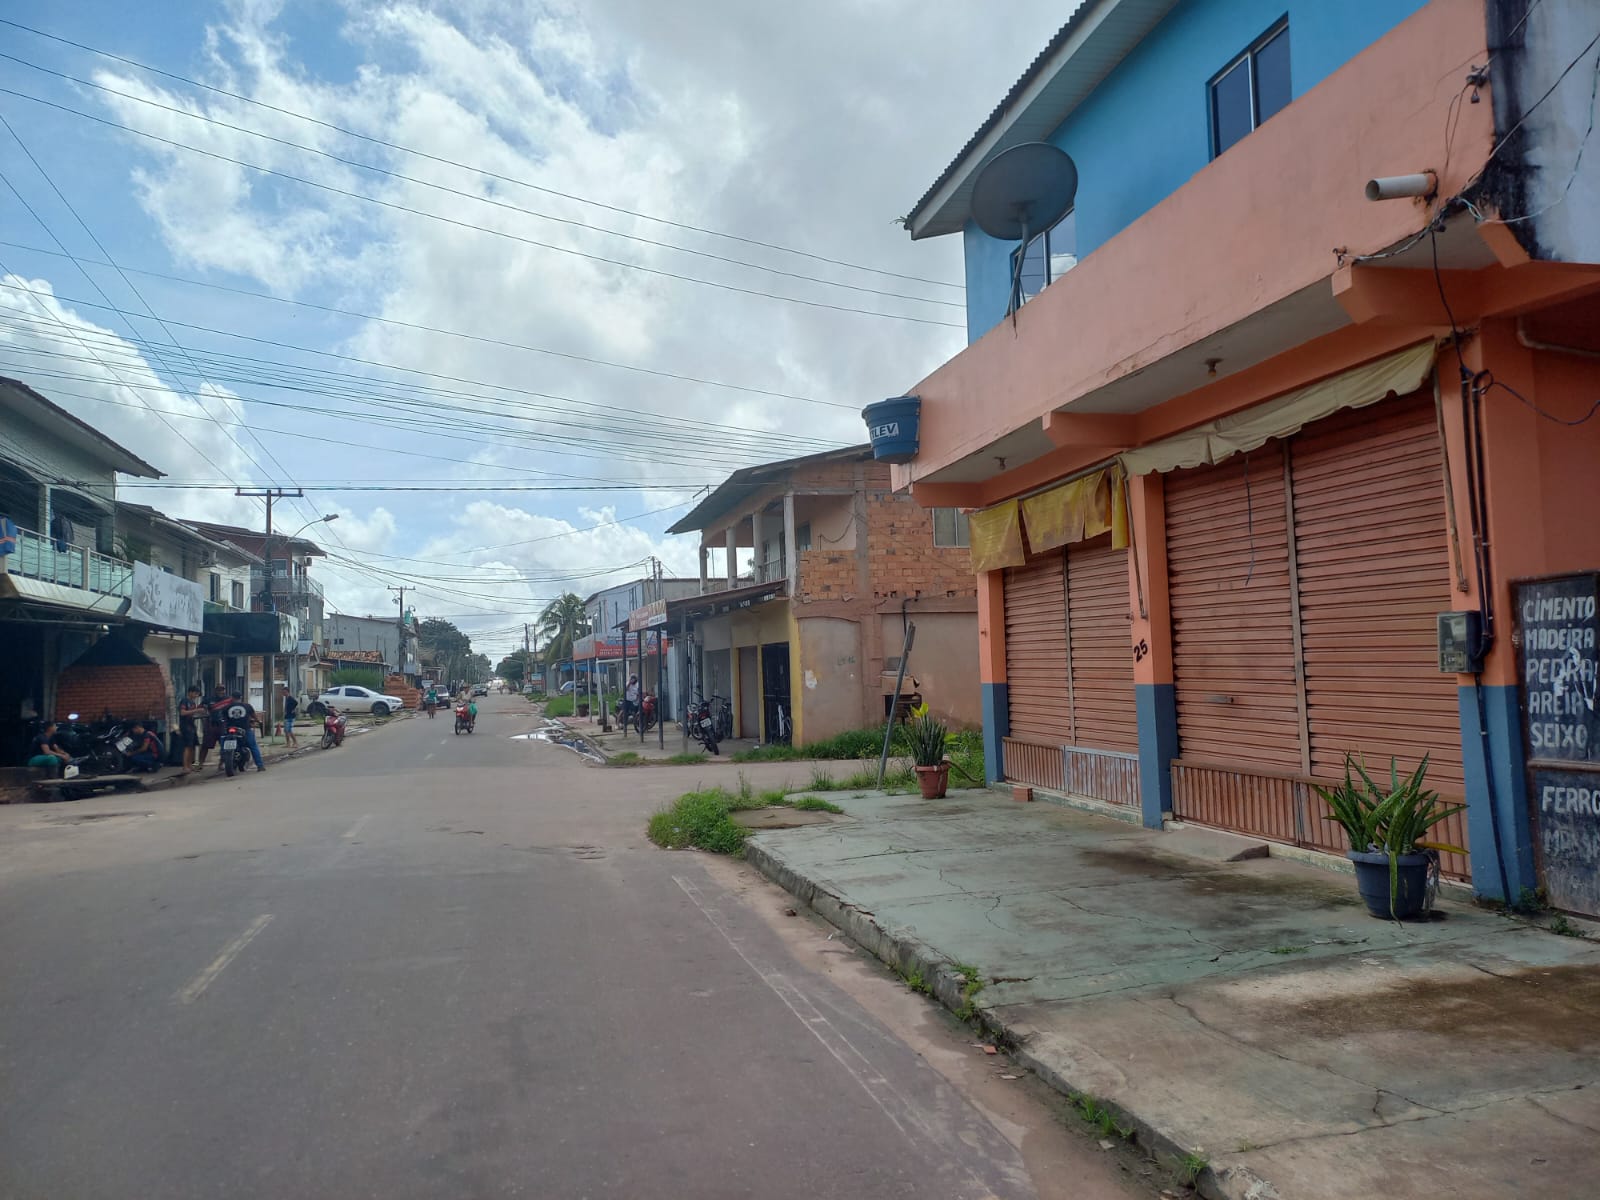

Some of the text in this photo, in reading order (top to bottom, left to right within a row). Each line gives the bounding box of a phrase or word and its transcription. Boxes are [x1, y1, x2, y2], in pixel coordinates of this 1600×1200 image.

[1134, 638, 1148, 662] 25
[1526, 658, 1593, 683] PEDRA
[1529, 690, 1584, 714] AREIA
